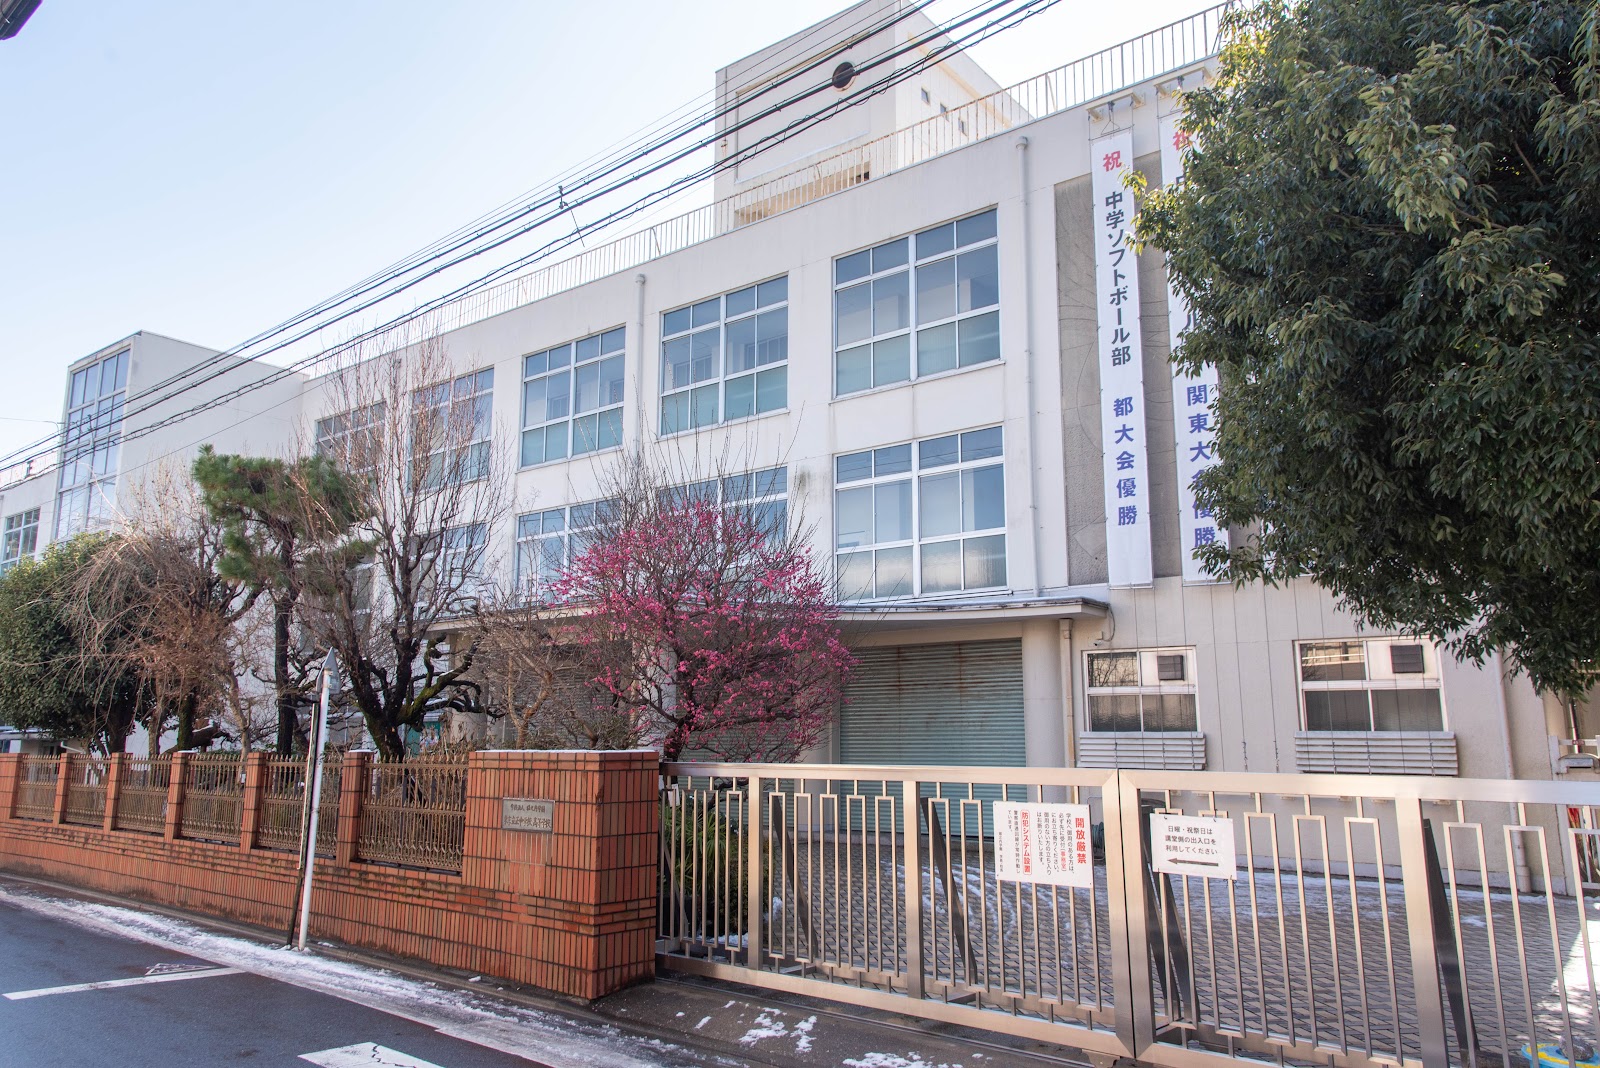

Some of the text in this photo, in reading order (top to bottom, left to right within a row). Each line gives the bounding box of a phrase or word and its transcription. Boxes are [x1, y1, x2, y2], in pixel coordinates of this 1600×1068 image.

[1103, 150, 1122, 172] 祝
[1105, 191, 1131, 366] 中学ソフトボール部
[1113, 396, 1137, 526] 都大会優勝
[1022, 812, 1030, 872] 防犯システム設置
[1075, 818, 1086, 864] 開放厳禁
[1166, 845, 1218, 855] 利用してください
[1168, 826, 1213, 834] 日曜・祝祭日は
